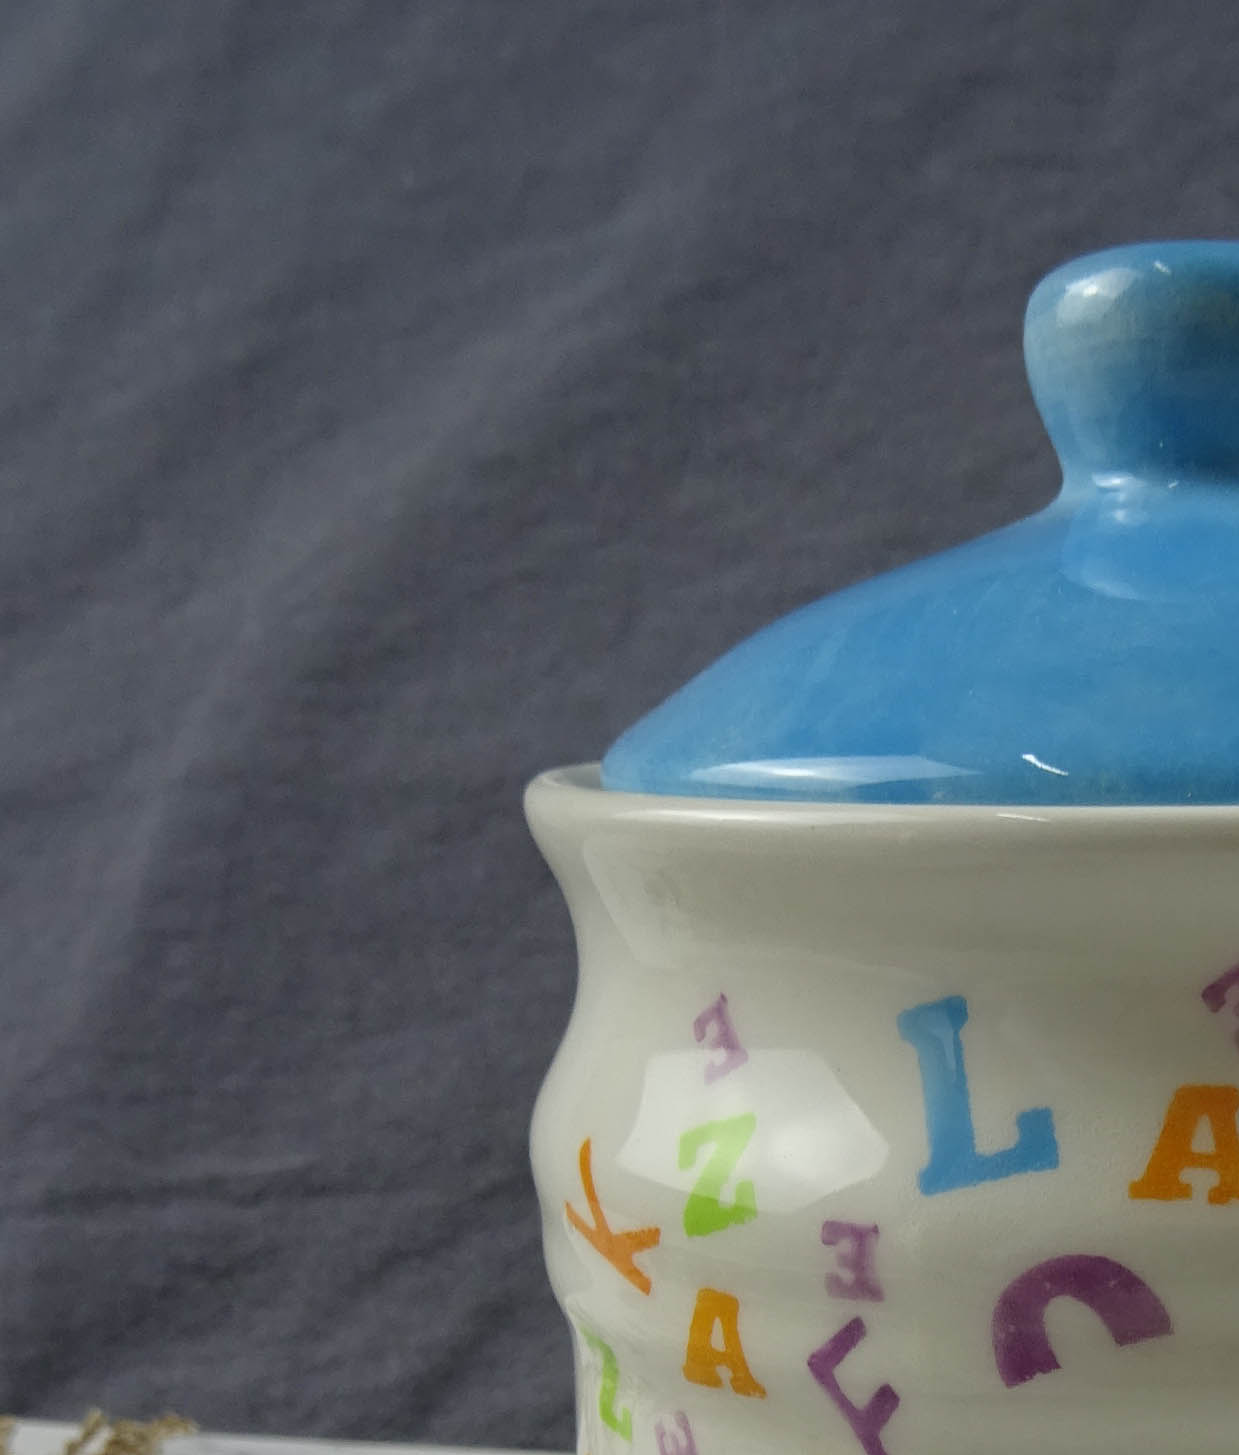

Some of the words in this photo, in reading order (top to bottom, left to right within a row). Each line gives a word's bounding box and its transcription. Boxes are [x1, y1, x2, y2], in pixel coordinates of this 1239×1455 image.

[897, 994, 1060, 1197] L
[564, 1137, 662, 1296] K
[677, 1112, 759, 1239] Z
[682, 1286, 768, 1400] A
